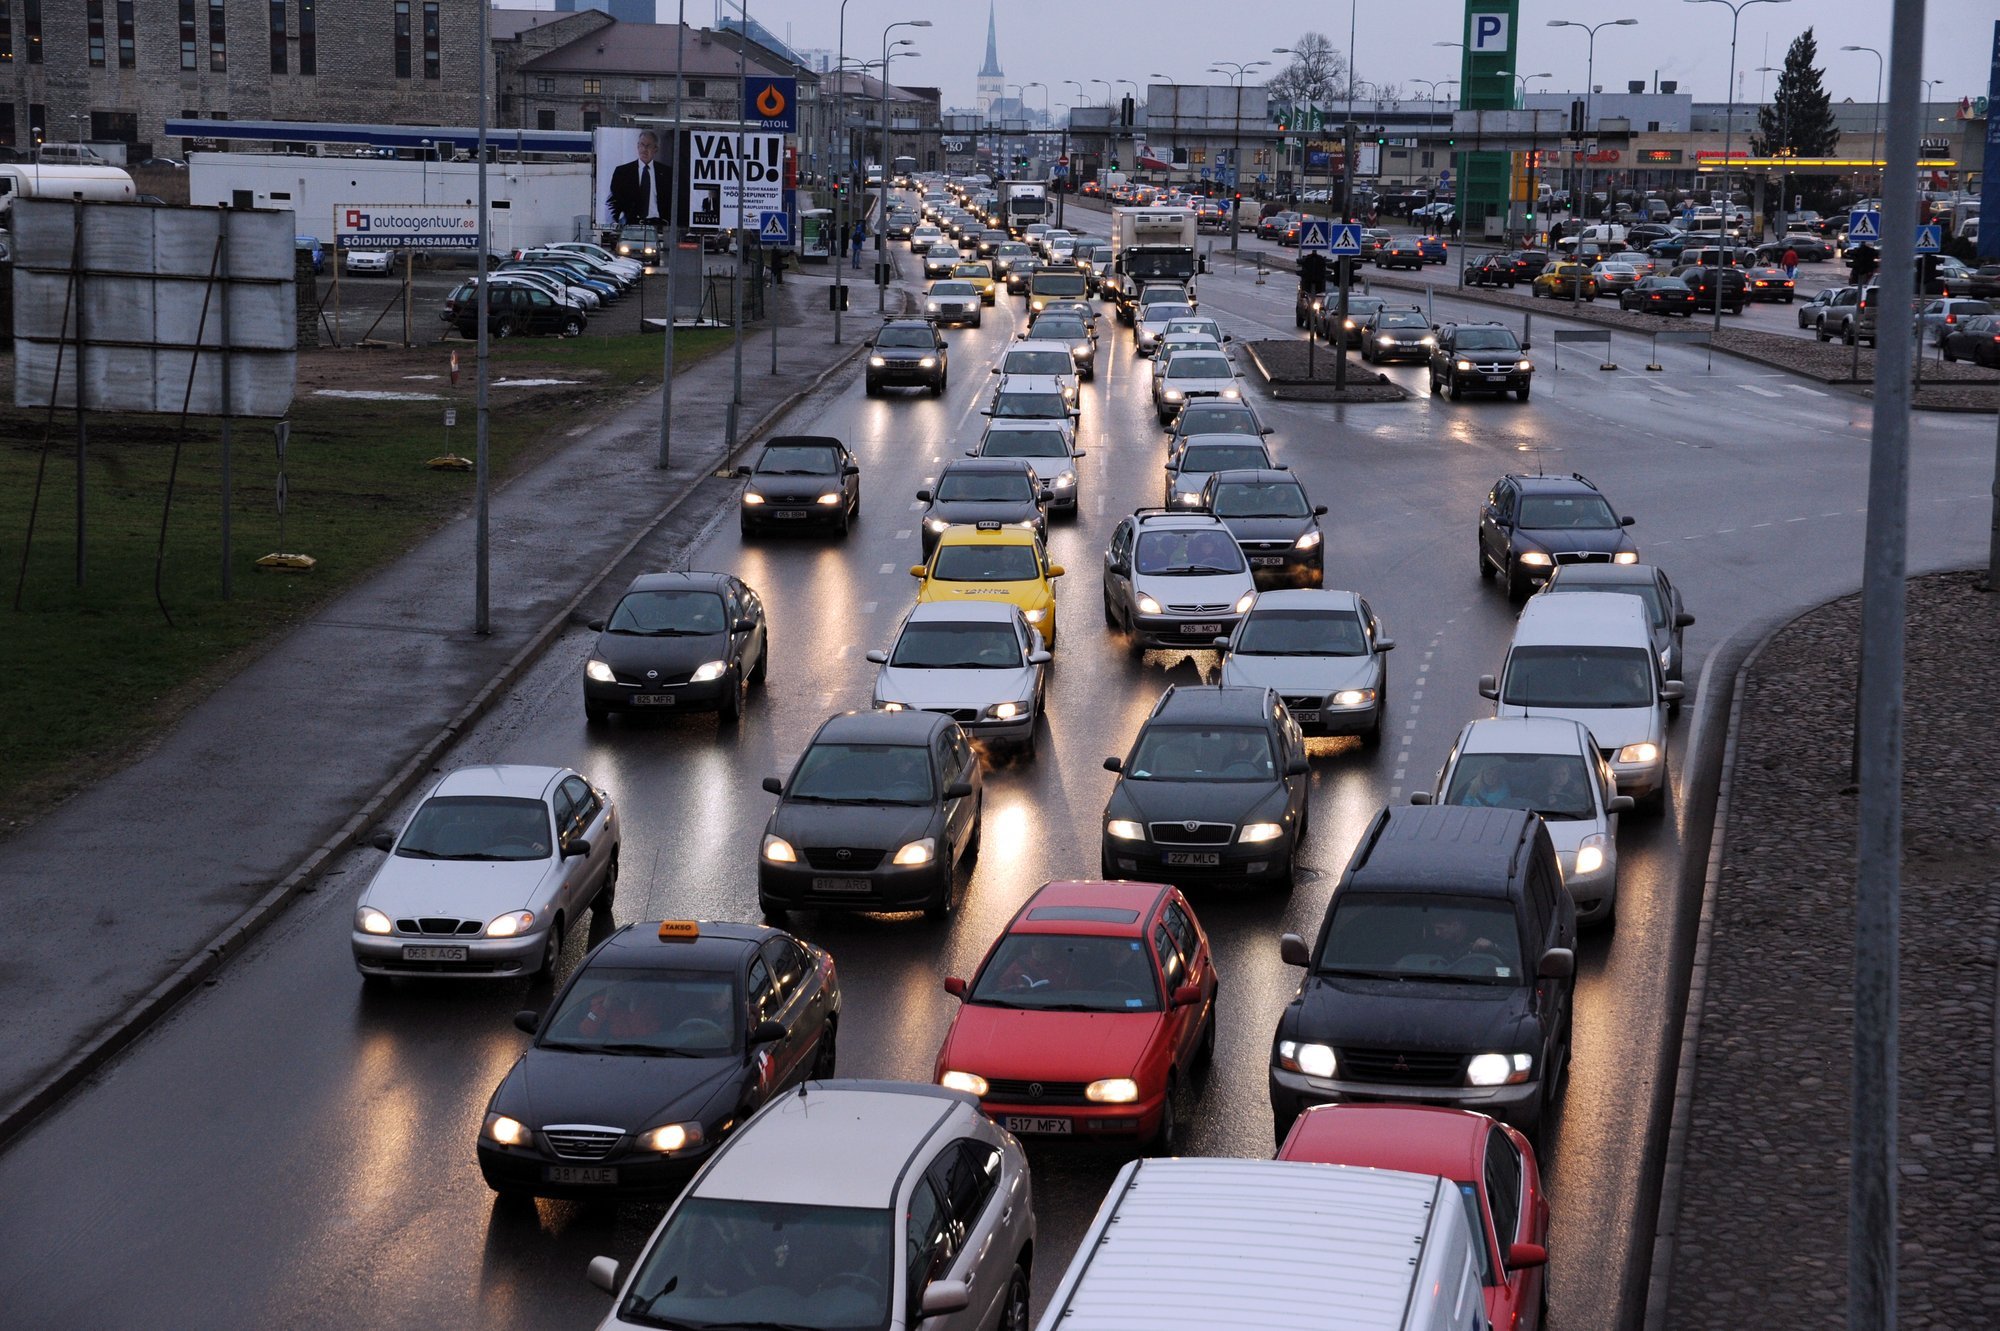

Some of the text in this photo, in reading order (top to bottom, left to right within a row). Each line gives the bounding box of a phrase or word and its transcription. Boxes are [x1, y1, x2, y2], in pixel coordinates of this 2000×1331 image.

[1477, 16, 1501, 48] P
[374, 215, 474, 231] autoagentuur.ee
[343, 235, 478, 246] SÕIDUKID SAKSAMAALT
[1171, 853, 1216, 864] 227 MLC
[1011, 1118, 1066, 1132] 517 MFX
[583, 1169, 612, 1182] AUE
